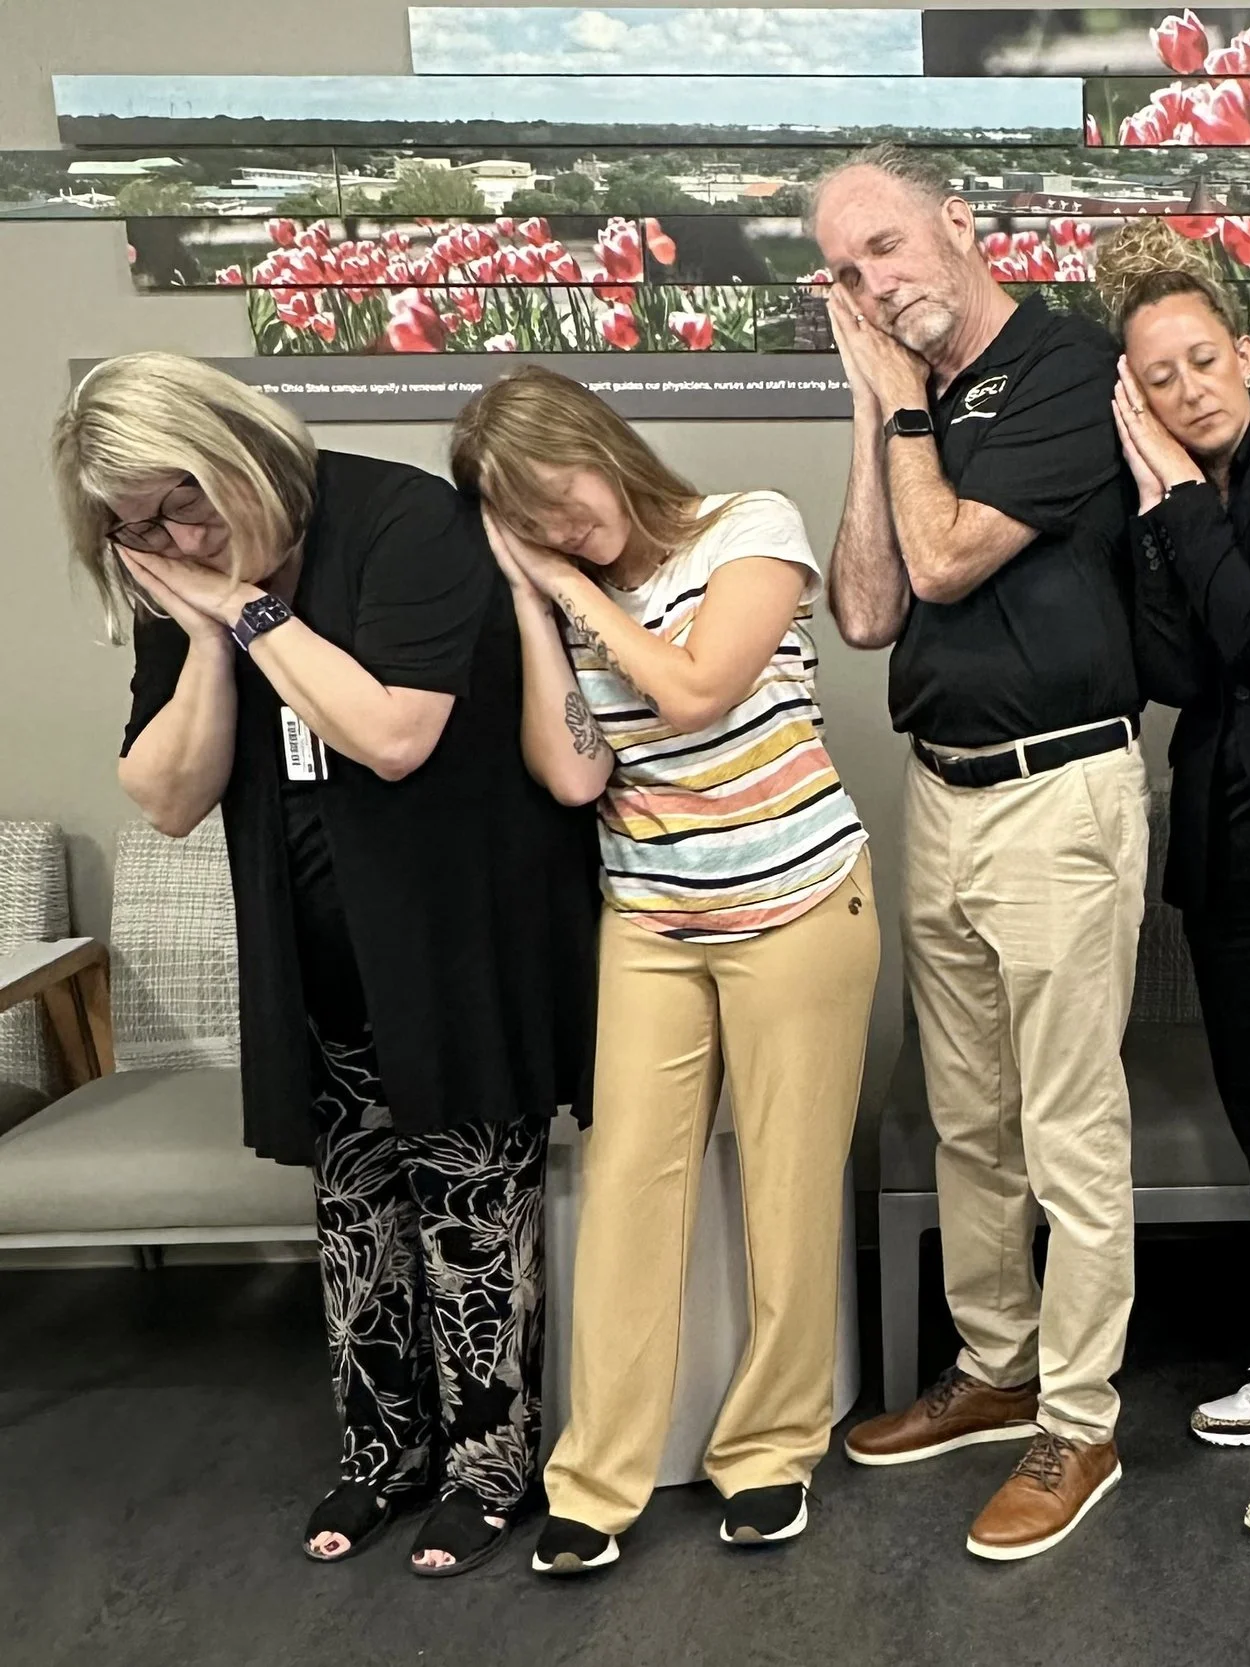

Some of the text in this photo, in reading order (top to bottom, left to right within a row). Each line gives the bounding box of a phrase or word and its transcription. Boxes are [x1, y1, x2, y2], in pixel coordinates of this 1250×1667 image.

[263, 384, 279, 393] the
[281, 383, 304, 393] Ohio
[305, 383, 330, 393] State
[331, 384, 368, 394] campus
[401, 383, 407, 392] a
[409, 383, 446, 392] renewal
[447, 382, 458, 392] of
[459, 382, 483, 393] hope
[612, 381, 644, 392] guides
[713, 382, 744, 390] nurses
[746, 380, 763, 390] and
[765, 380, 786, 390] staff
[787, 380, 796, 390] in
[797, 380, 826, 391] caring
[828, 380, 840, 390] for
